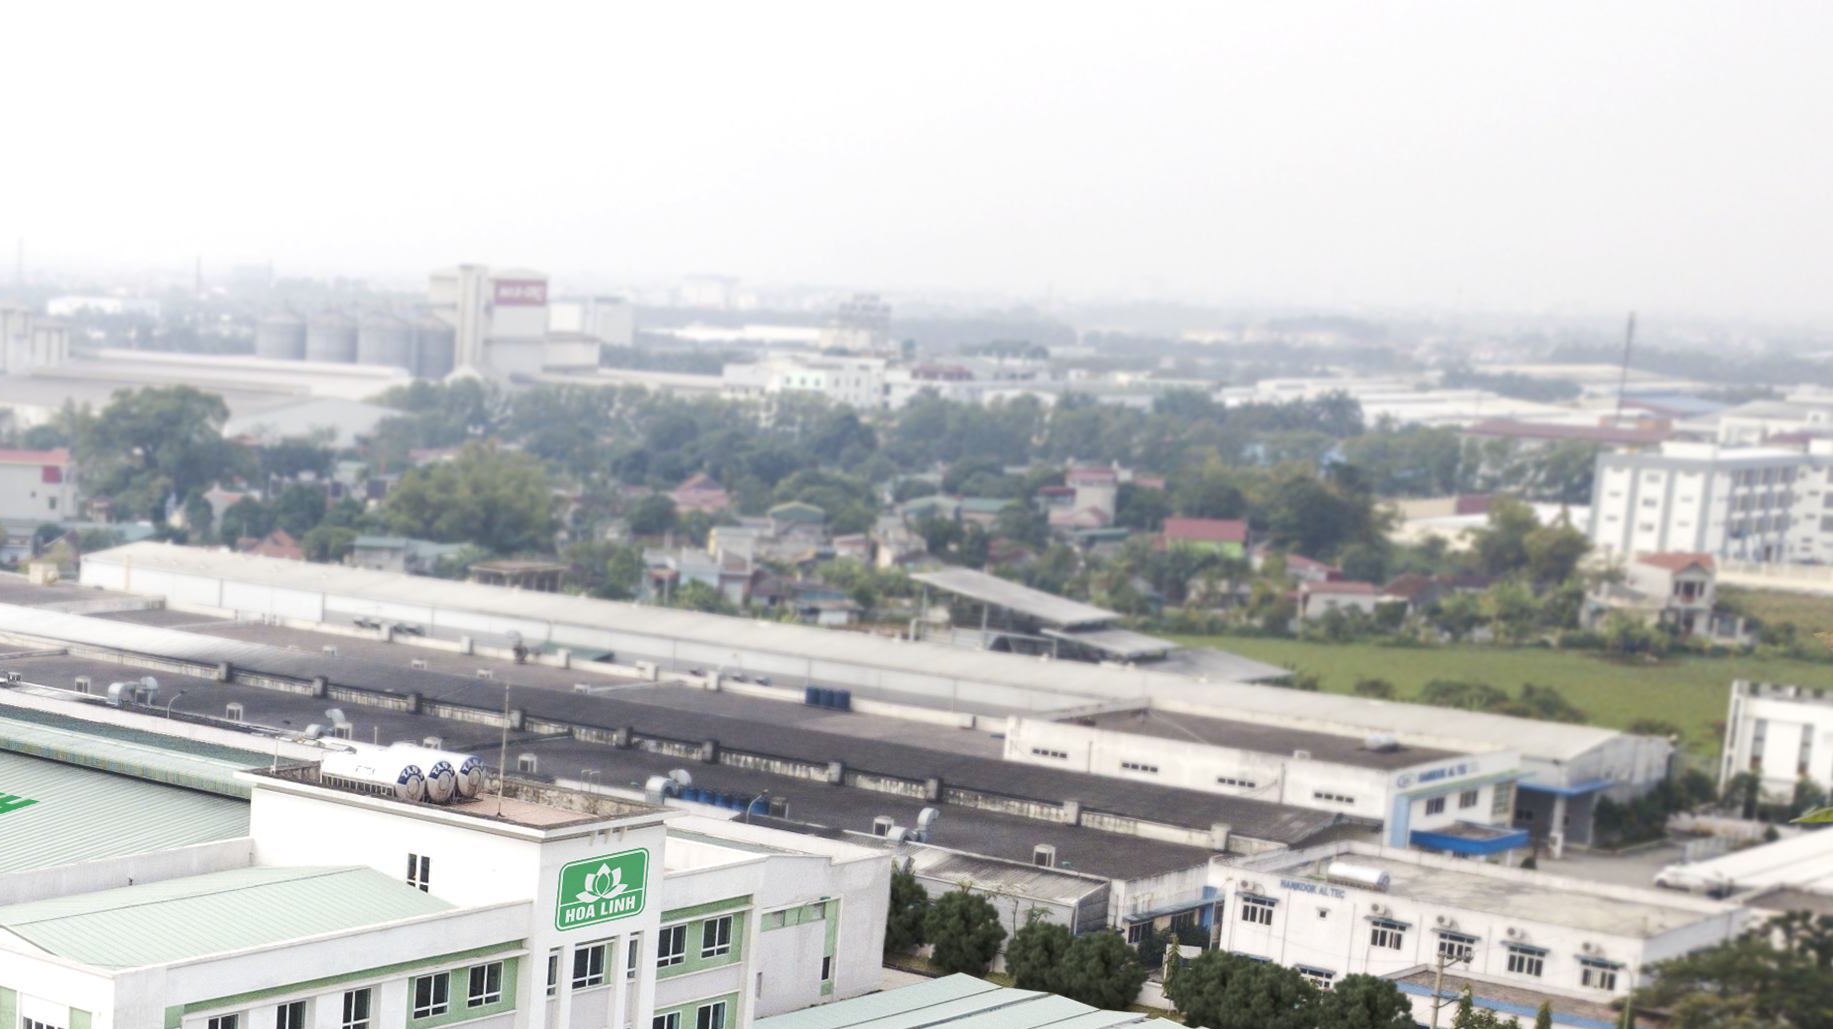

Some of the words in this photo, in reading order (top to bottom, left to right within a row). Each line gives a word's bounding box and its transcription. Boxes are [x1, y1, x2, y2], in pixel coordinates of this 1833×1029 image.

[1330, 887, 1346, 899] TEC
[565, 904, 596, 924] HOA
[600, 895, 636, 916] LINH
